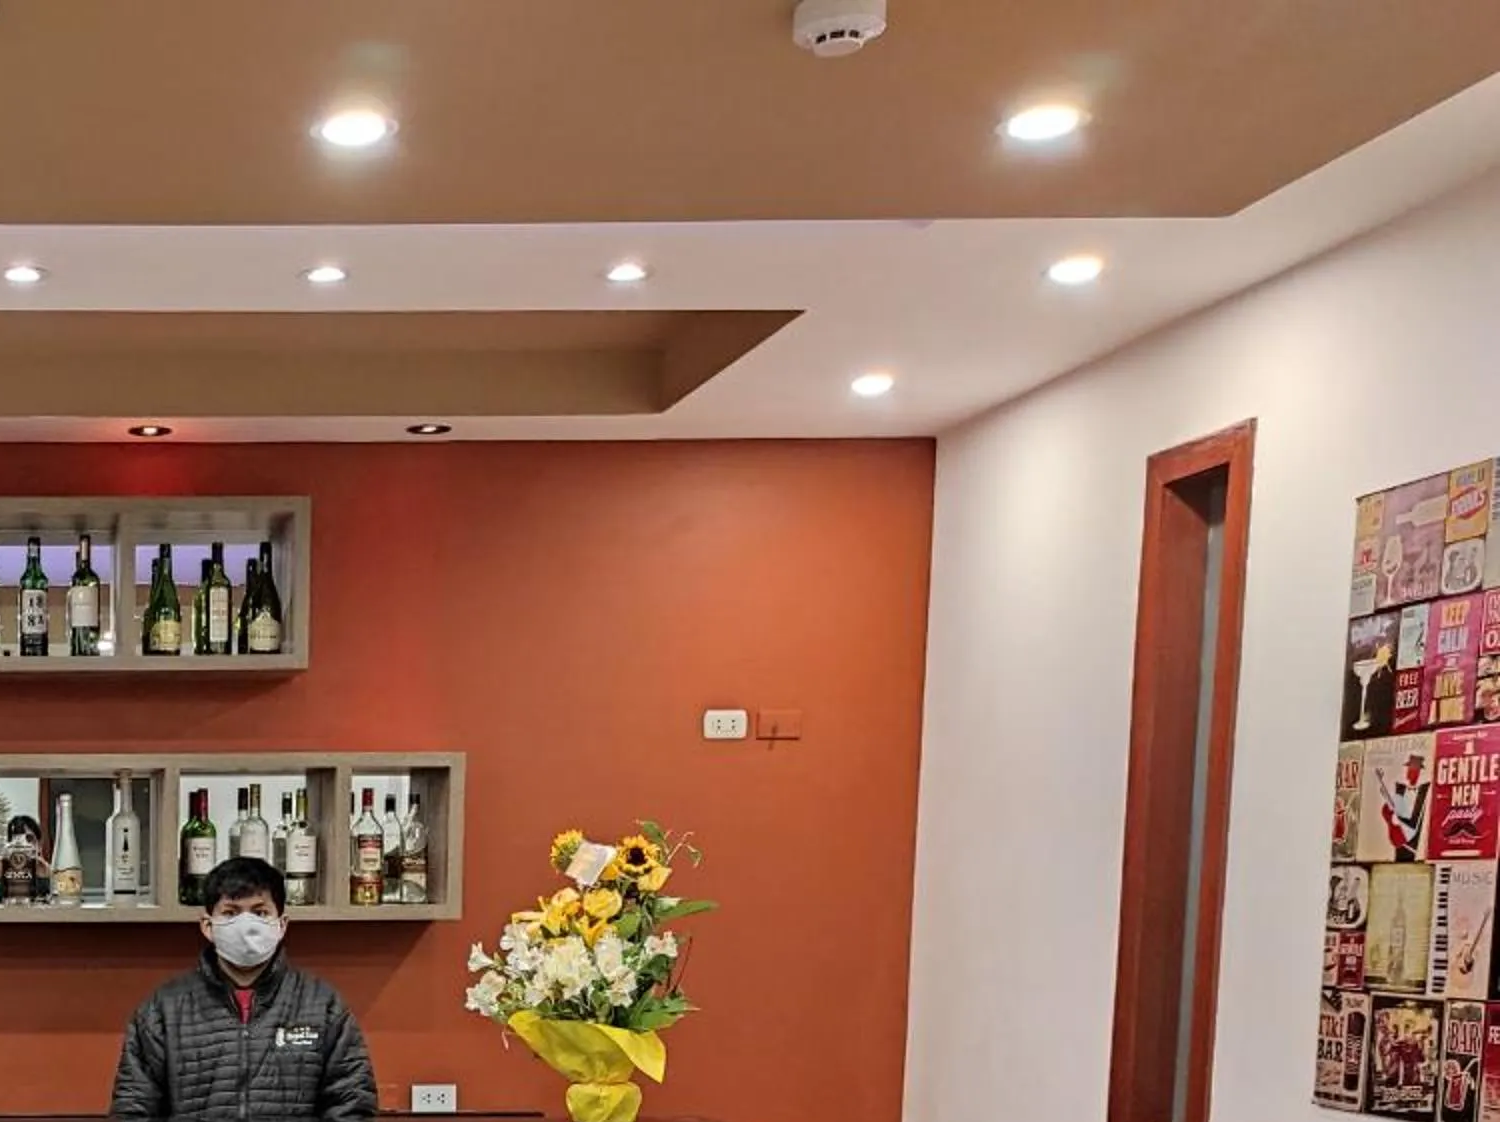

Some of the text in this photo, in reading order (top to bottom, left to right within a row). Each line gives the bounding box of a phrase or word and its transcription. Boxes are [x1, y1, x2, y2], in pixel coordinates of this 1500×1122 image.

[1437, 754, 1499, 785] GENTLE
[1451, 784, 1480, 807] MEN
[1451, 870, 1493, 886] MUSIC
[1316, 1037, 1343, 1063] BAR
[1448, 1021, 1482, 1055] BAR
